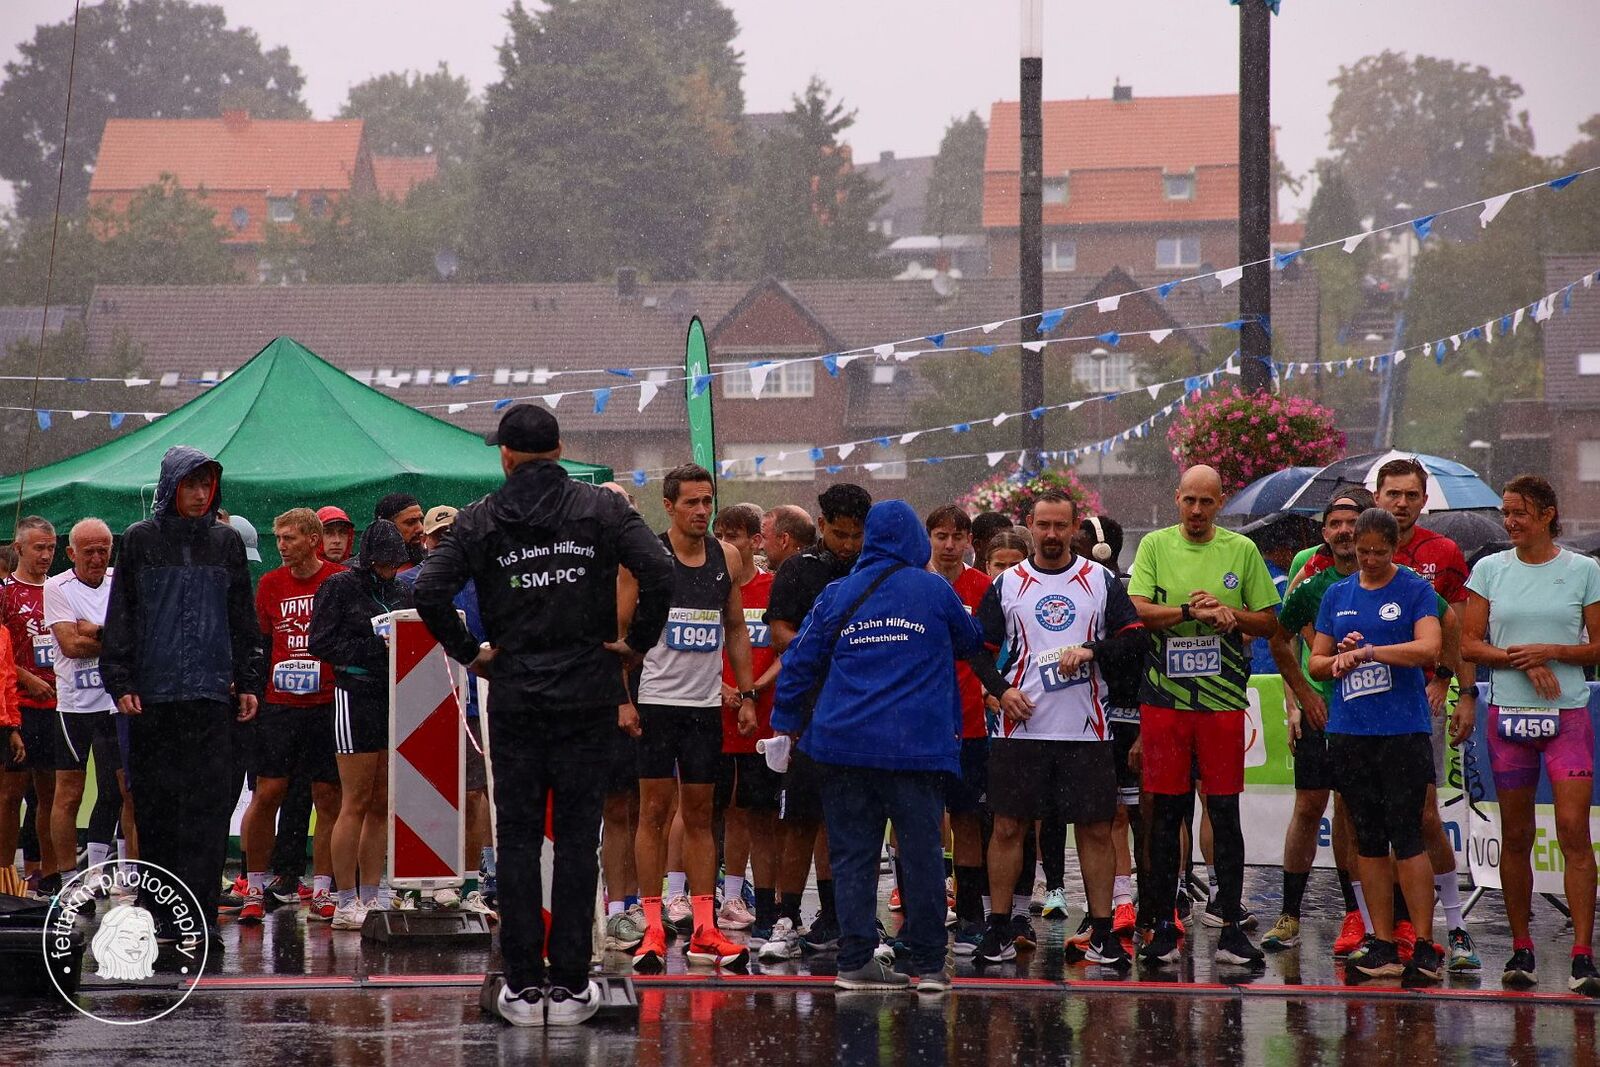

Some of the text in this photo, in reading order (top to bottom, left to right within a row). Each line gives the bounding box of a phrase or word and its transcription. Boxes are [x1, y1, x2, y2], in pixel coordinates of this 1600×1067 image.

[496, 541, 595, 567] TuS Jahn Hilfarth
[858, 619, 882, 631] Jahn
[886, 618, 925, 634] Hilfarth
[672, 626, 717, 646] 1994
[849, 634, 908, 645] Leichtathletik
[1172, 637, 1216, 649] wep-Lauf
[1171, 652, 1218, 671] 1692
[78, 671, 103, 688] 16
[276, 672, 315, 690] 1671
[1345, 667, 1389, 693] 1682
[1502, 718, 1555, 737] 1459
